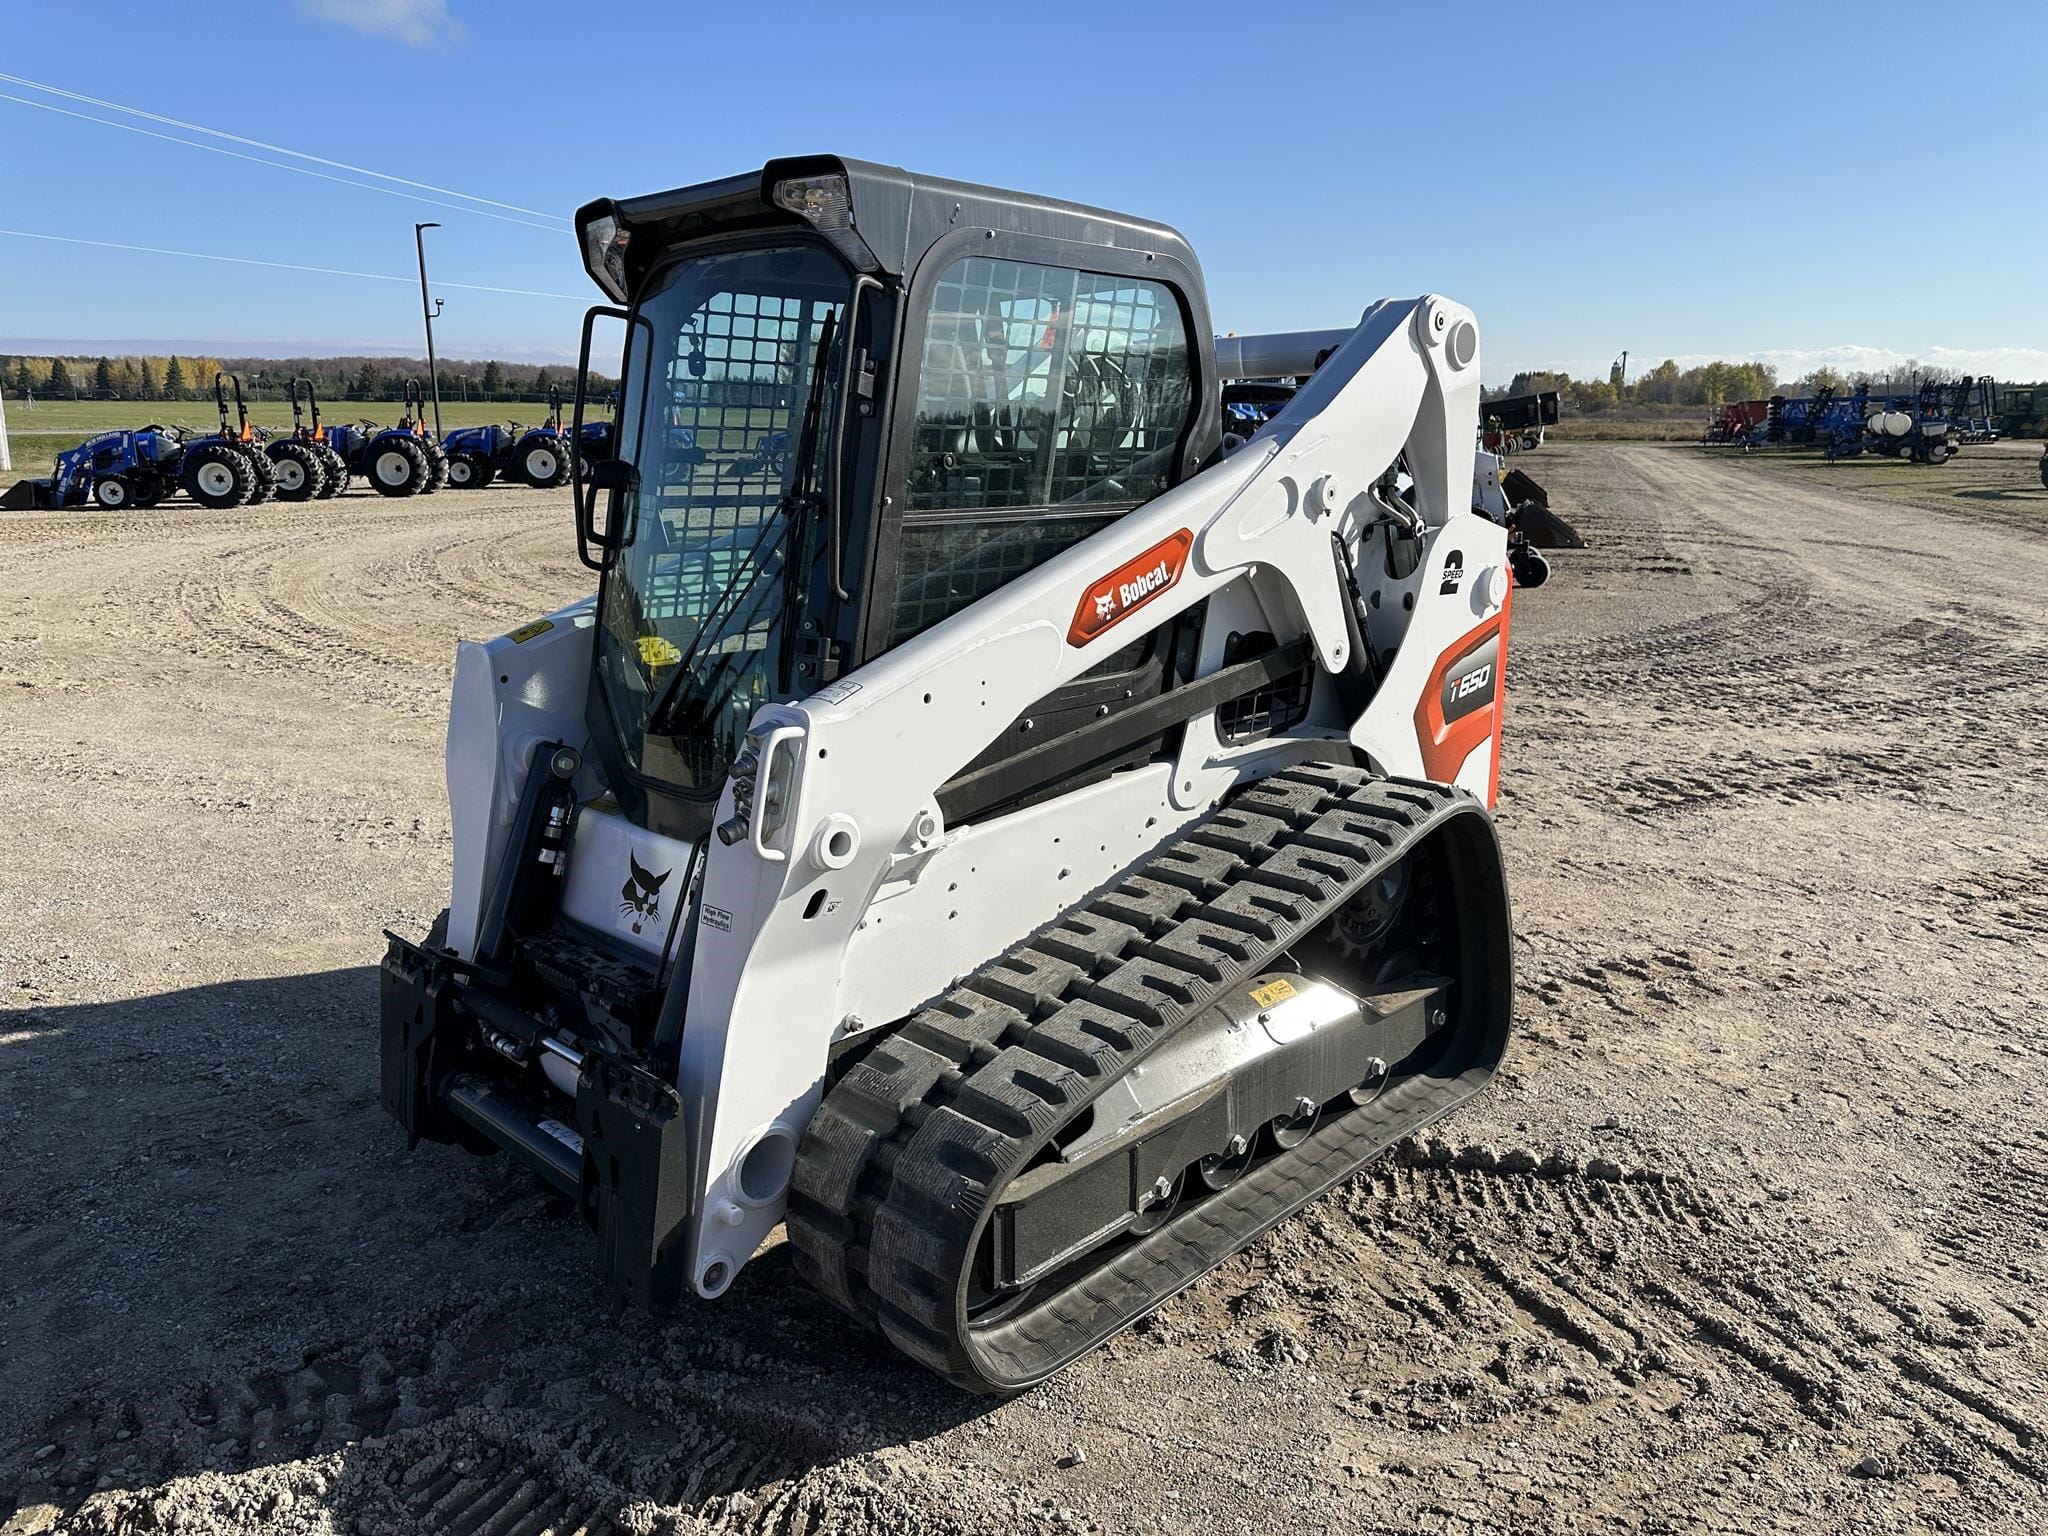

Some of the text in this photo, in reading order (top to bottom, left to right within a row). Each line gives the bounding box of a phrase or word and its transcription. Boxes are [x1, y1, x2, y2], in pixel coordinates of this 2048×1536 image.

[1439, 549, 1464, 596] 2
[1442, 569, 1464, 580] SPEED
[1450, 663, 1491, 703] T650
[704, 907, 730, 921] High Flow
[703, 915, 729, 929] Hydraulics
